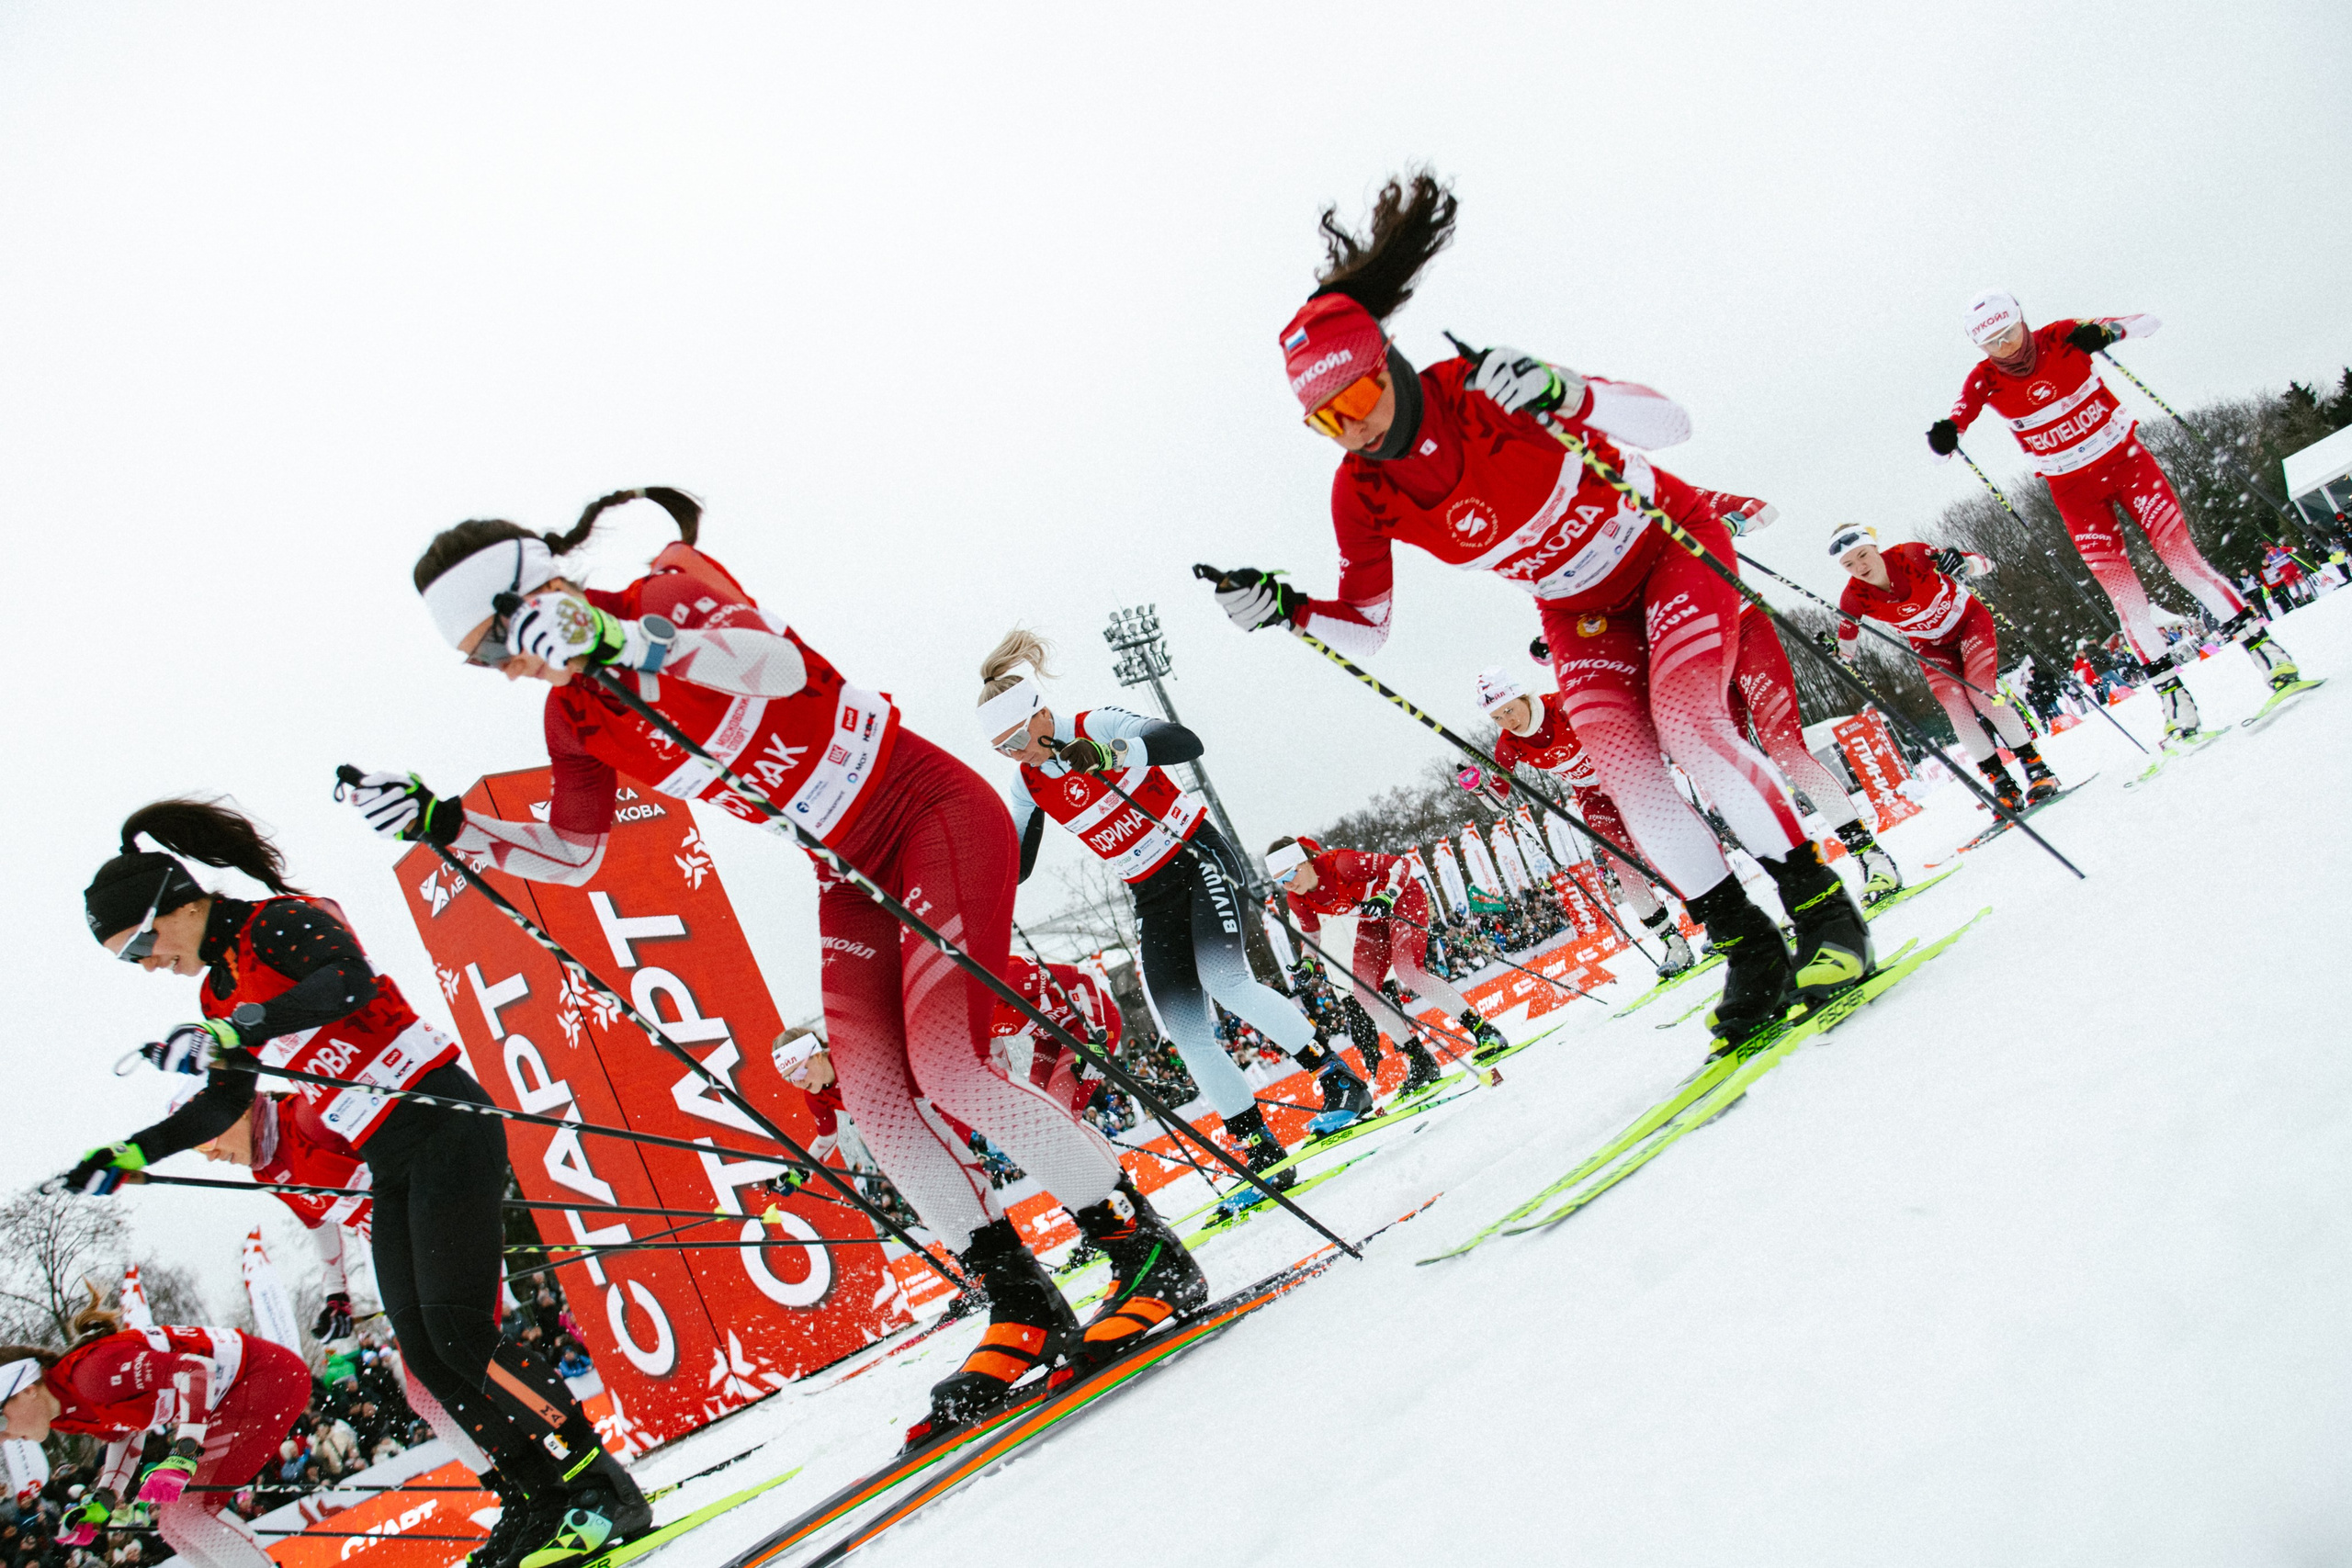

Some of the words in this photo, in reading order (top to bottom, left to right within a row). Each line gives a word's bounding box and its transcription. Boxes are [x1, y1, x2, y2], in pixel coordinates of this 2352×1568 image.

[1972, 310, 2010, 337] ЛУКОЙЛ
[1293, 349, 1353, 395] ЛУКОЙЛ
[1558, 658, 1638, 678] ЛУКОЙЛ
[1794, 880, 1841, 913] FISCHER
[821, 935, 876, 960] КОЙЛ
[1816, 988, 1867, 1030] FISCHER
[1736, 1021, 1785, 1065] FISCHER
[588, 891, 831, 1308] СТАРТ
[1320, 1129, 1353, 1148] FISCHER
[465, 962, 675, 1377] СТАРТ
